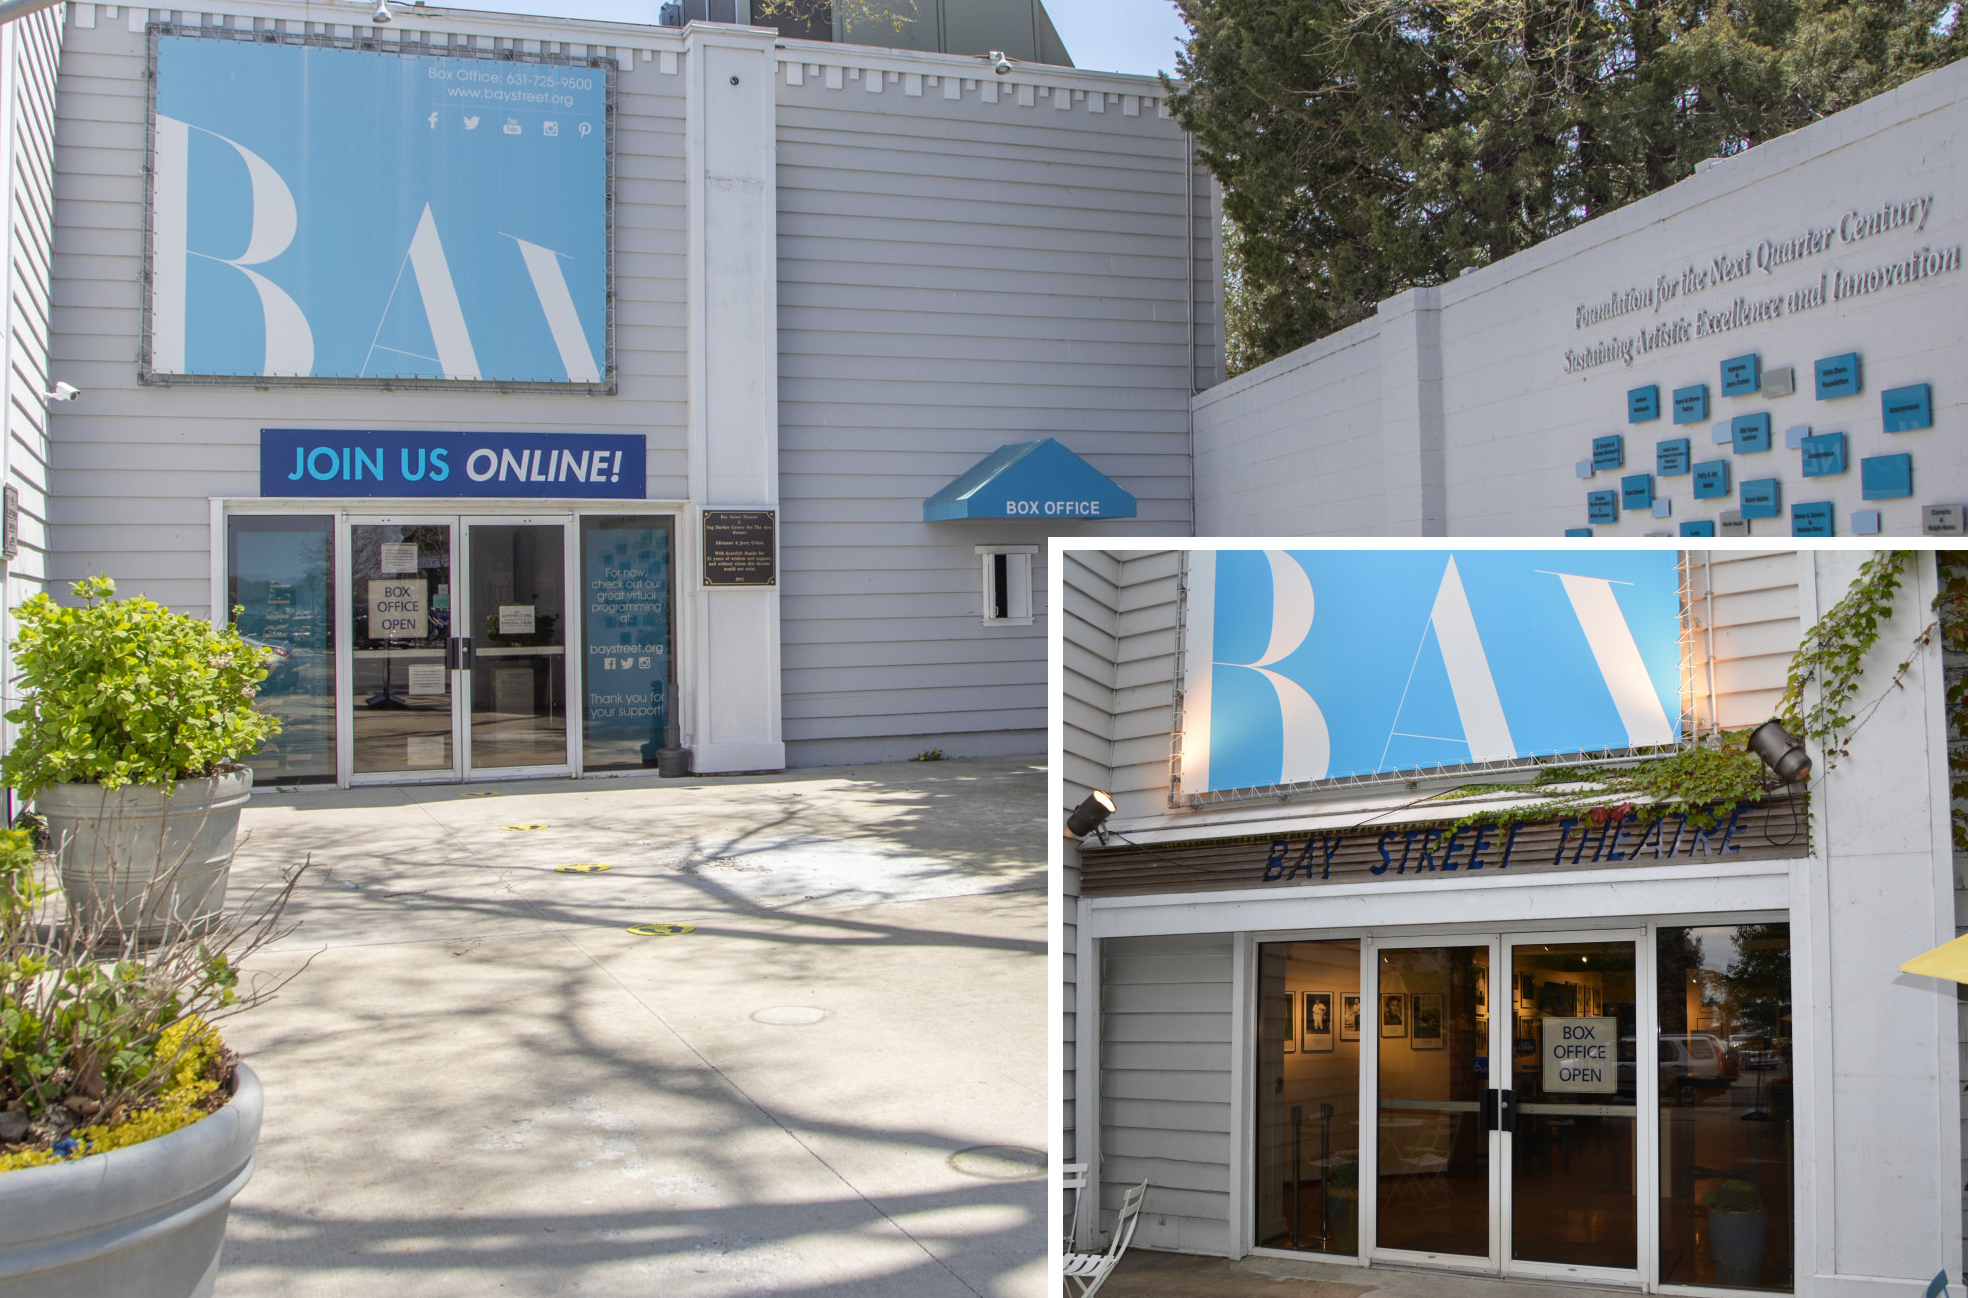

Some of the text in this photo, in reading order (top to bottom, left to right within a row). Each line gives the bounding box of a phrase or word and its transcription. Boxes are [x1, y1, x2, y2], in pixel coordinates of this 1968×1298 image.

[428, 67, 592, 90] Box Office: 631-725-9500
[447, 87, 574, 108] www.baystreet.org
[1574, 194, 1933, 329] Foundation for the Next Quarter Century
[1562, 245, 1961, 373] Sustaining Artistic Excellence and Innovation
[287, 446, 623, 483] JOIN US ONLINE!
[1006, 501, 1100, 515] BOX OFFICE
[605, 568, 648, 578] For now,
[592, 580, 662, 589] check out our
[384, 587, 411, 598] BOX
[597, 590, 656, 602] great virtual
[377, 601, 420, 612] OFFICE
[592, 602, 662, 614] programming
[381, 619, 416, 630] OPEN
[590, 644, 664, 655] baystreet.org
[590, 692, 665, 706] Thank you for
[590, 705, 664, 720] your support!
[1263, 807, 1754, 882] BAY STREET THEATRE
[1563, 1026, 1596, 1040] BOX
[1554, 1044, 1606, 1059] OFFICE
[1559, 1068, 1602, 1082] OPEN
